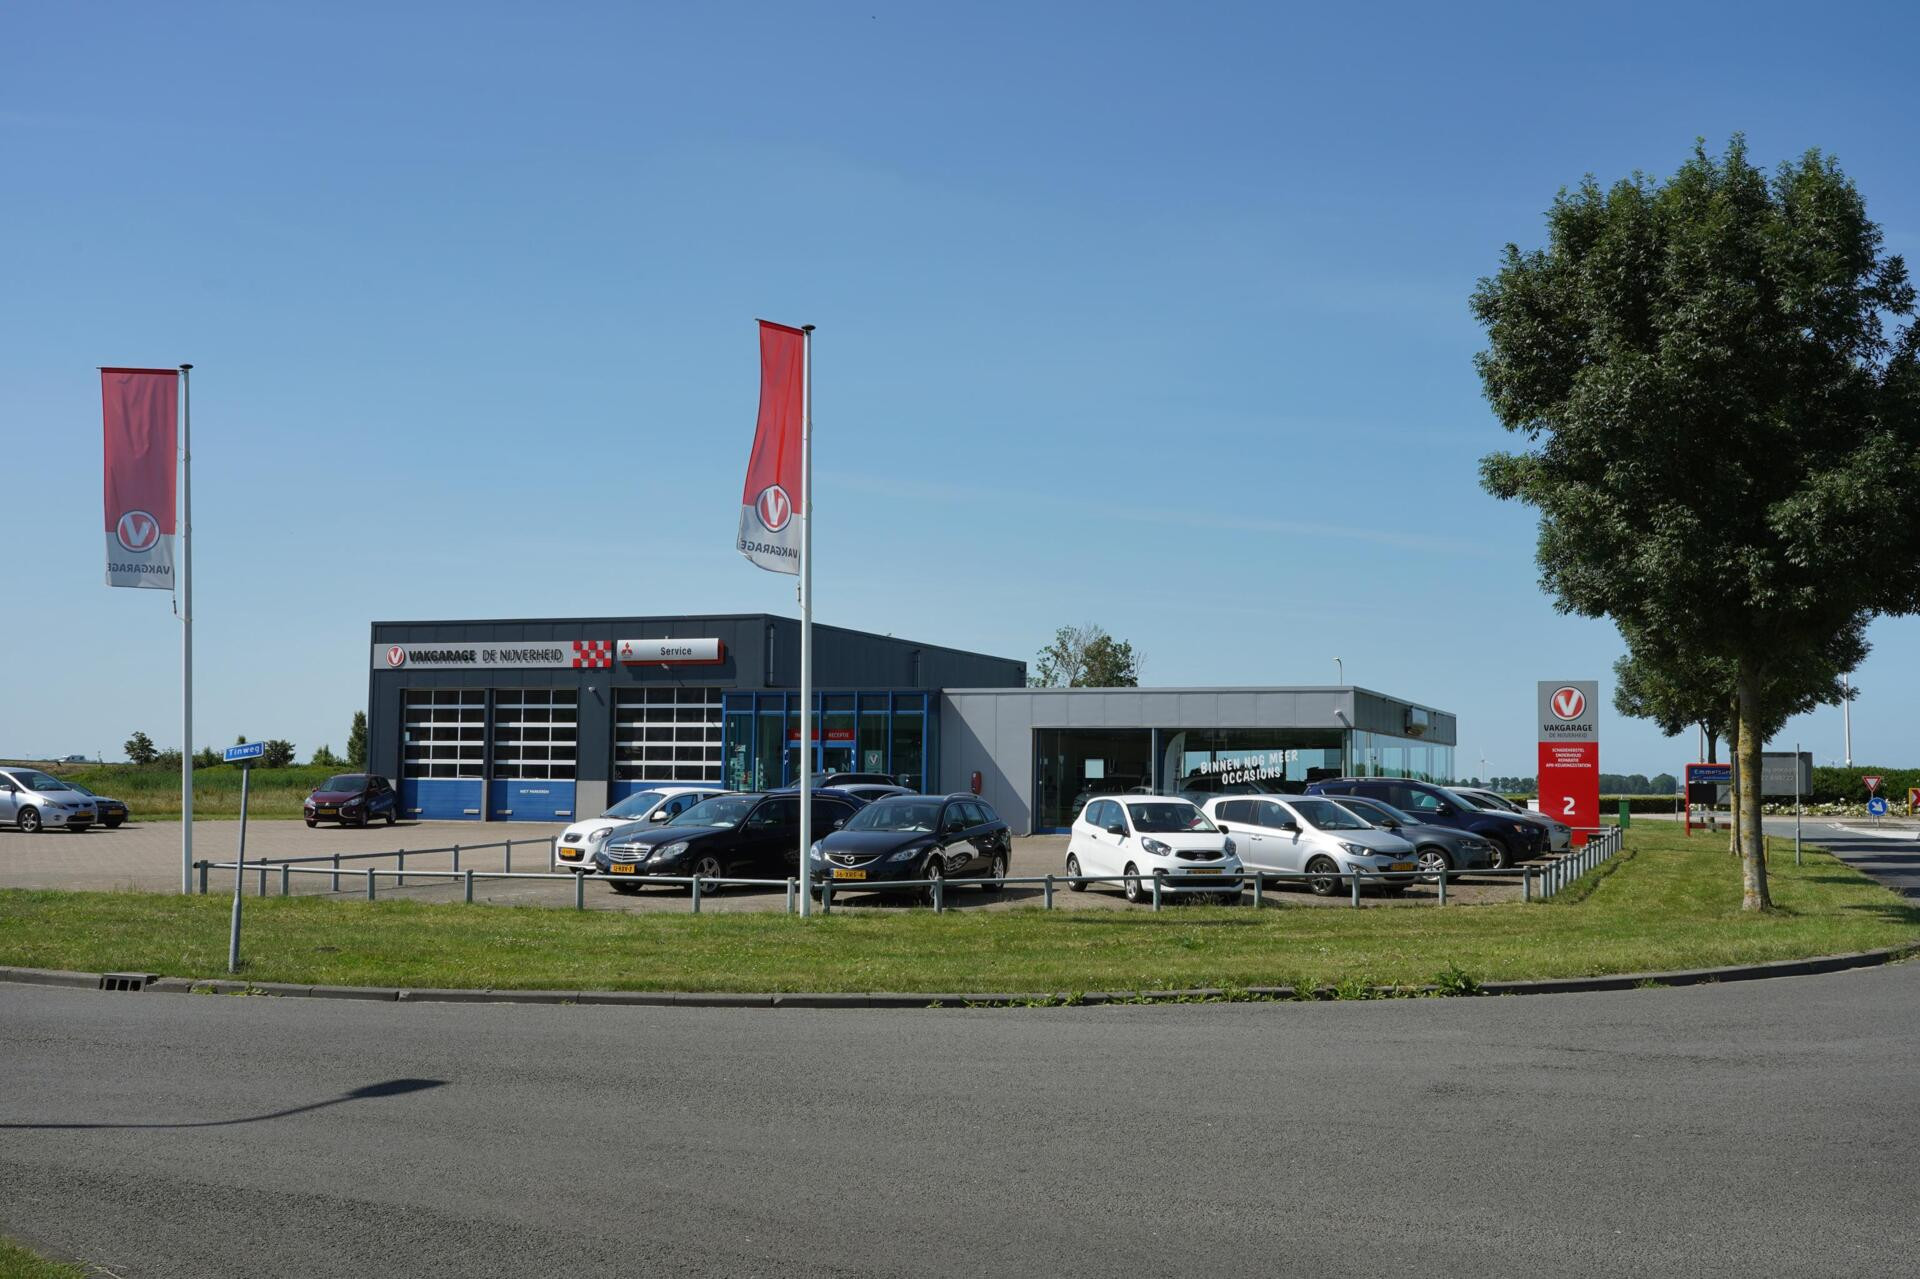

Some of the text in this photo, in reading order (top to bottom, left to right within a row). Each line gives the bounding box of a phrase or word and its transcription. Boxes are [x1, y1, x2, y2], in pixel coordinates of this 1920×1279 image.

[408, 648, 563, 663] VAKGARAGE DE NIJVERHEID
[660, 646, 692, 656] Service
[1543, 724, 1593, 732] VAKGARAGE
[229, 745, 260, 756] Tinweg
[1200, 749, 1298, 775] BINNEN NOG MEER
[1221, 766, 1281, 785] OCCASIONS
[1563, 796, 1576, 815] 2
